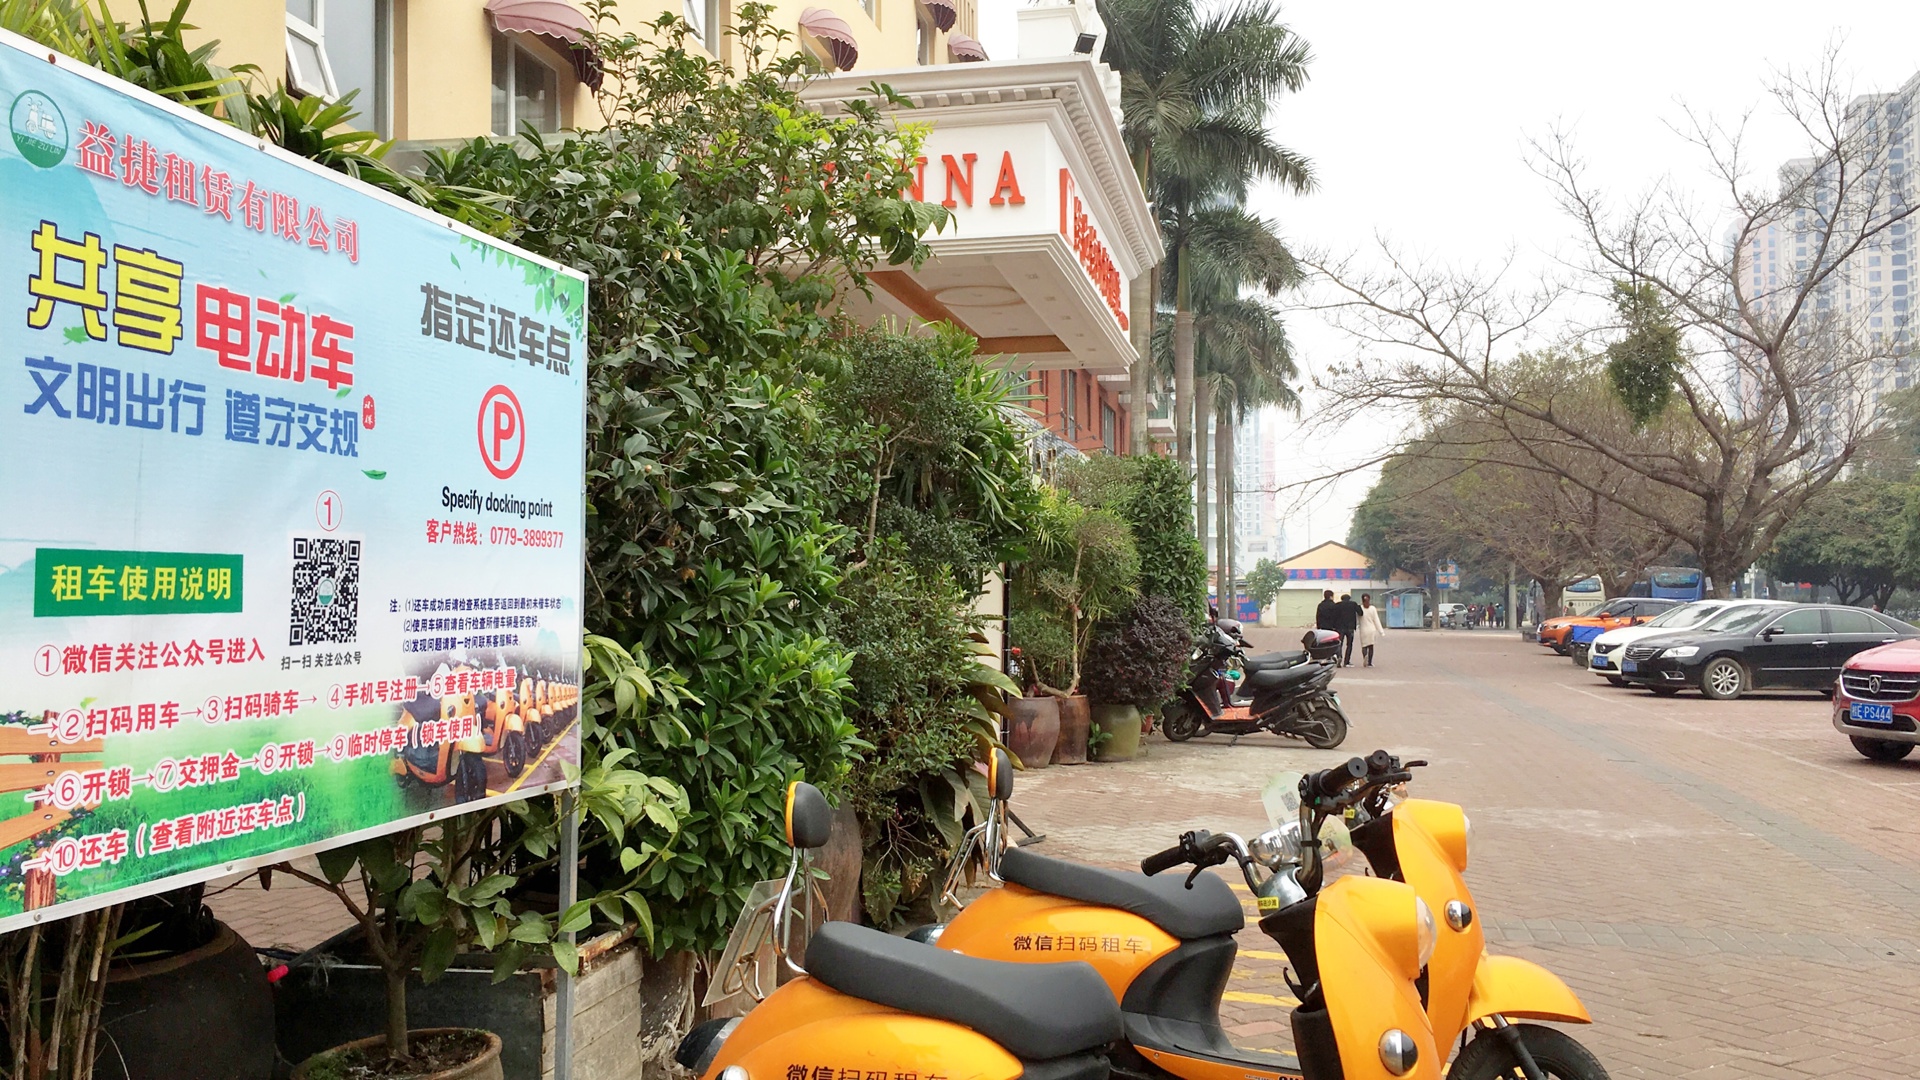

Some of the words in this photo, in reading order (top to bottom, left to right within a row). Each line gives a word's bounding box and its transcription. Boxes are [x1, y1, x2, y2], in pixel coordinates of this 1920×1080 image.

[76, 119, 360, 263] 益捷租赁有限公司
[27, 219, 184, 355] 共享
[195, 283, 354, 390] 电动车
[420, 282, 570, 376] 指定还车点
[24, 355, 207, 436] 文明出行
[225, 388, 359, 458] 遵守交规
[493, 400, 516, 462] P
[441, 485, 484, 514] Specify
[486, 491, 526, 519] docking
[528, 499, 553, 520] point
[51, 563, 232, 602] 租车使用说明
[281, 654, 312, 670] 扫一扫
[314, 651, 362, 668] 关注公众号
[1013, 935, 1144, 954] 微信扫码租车
